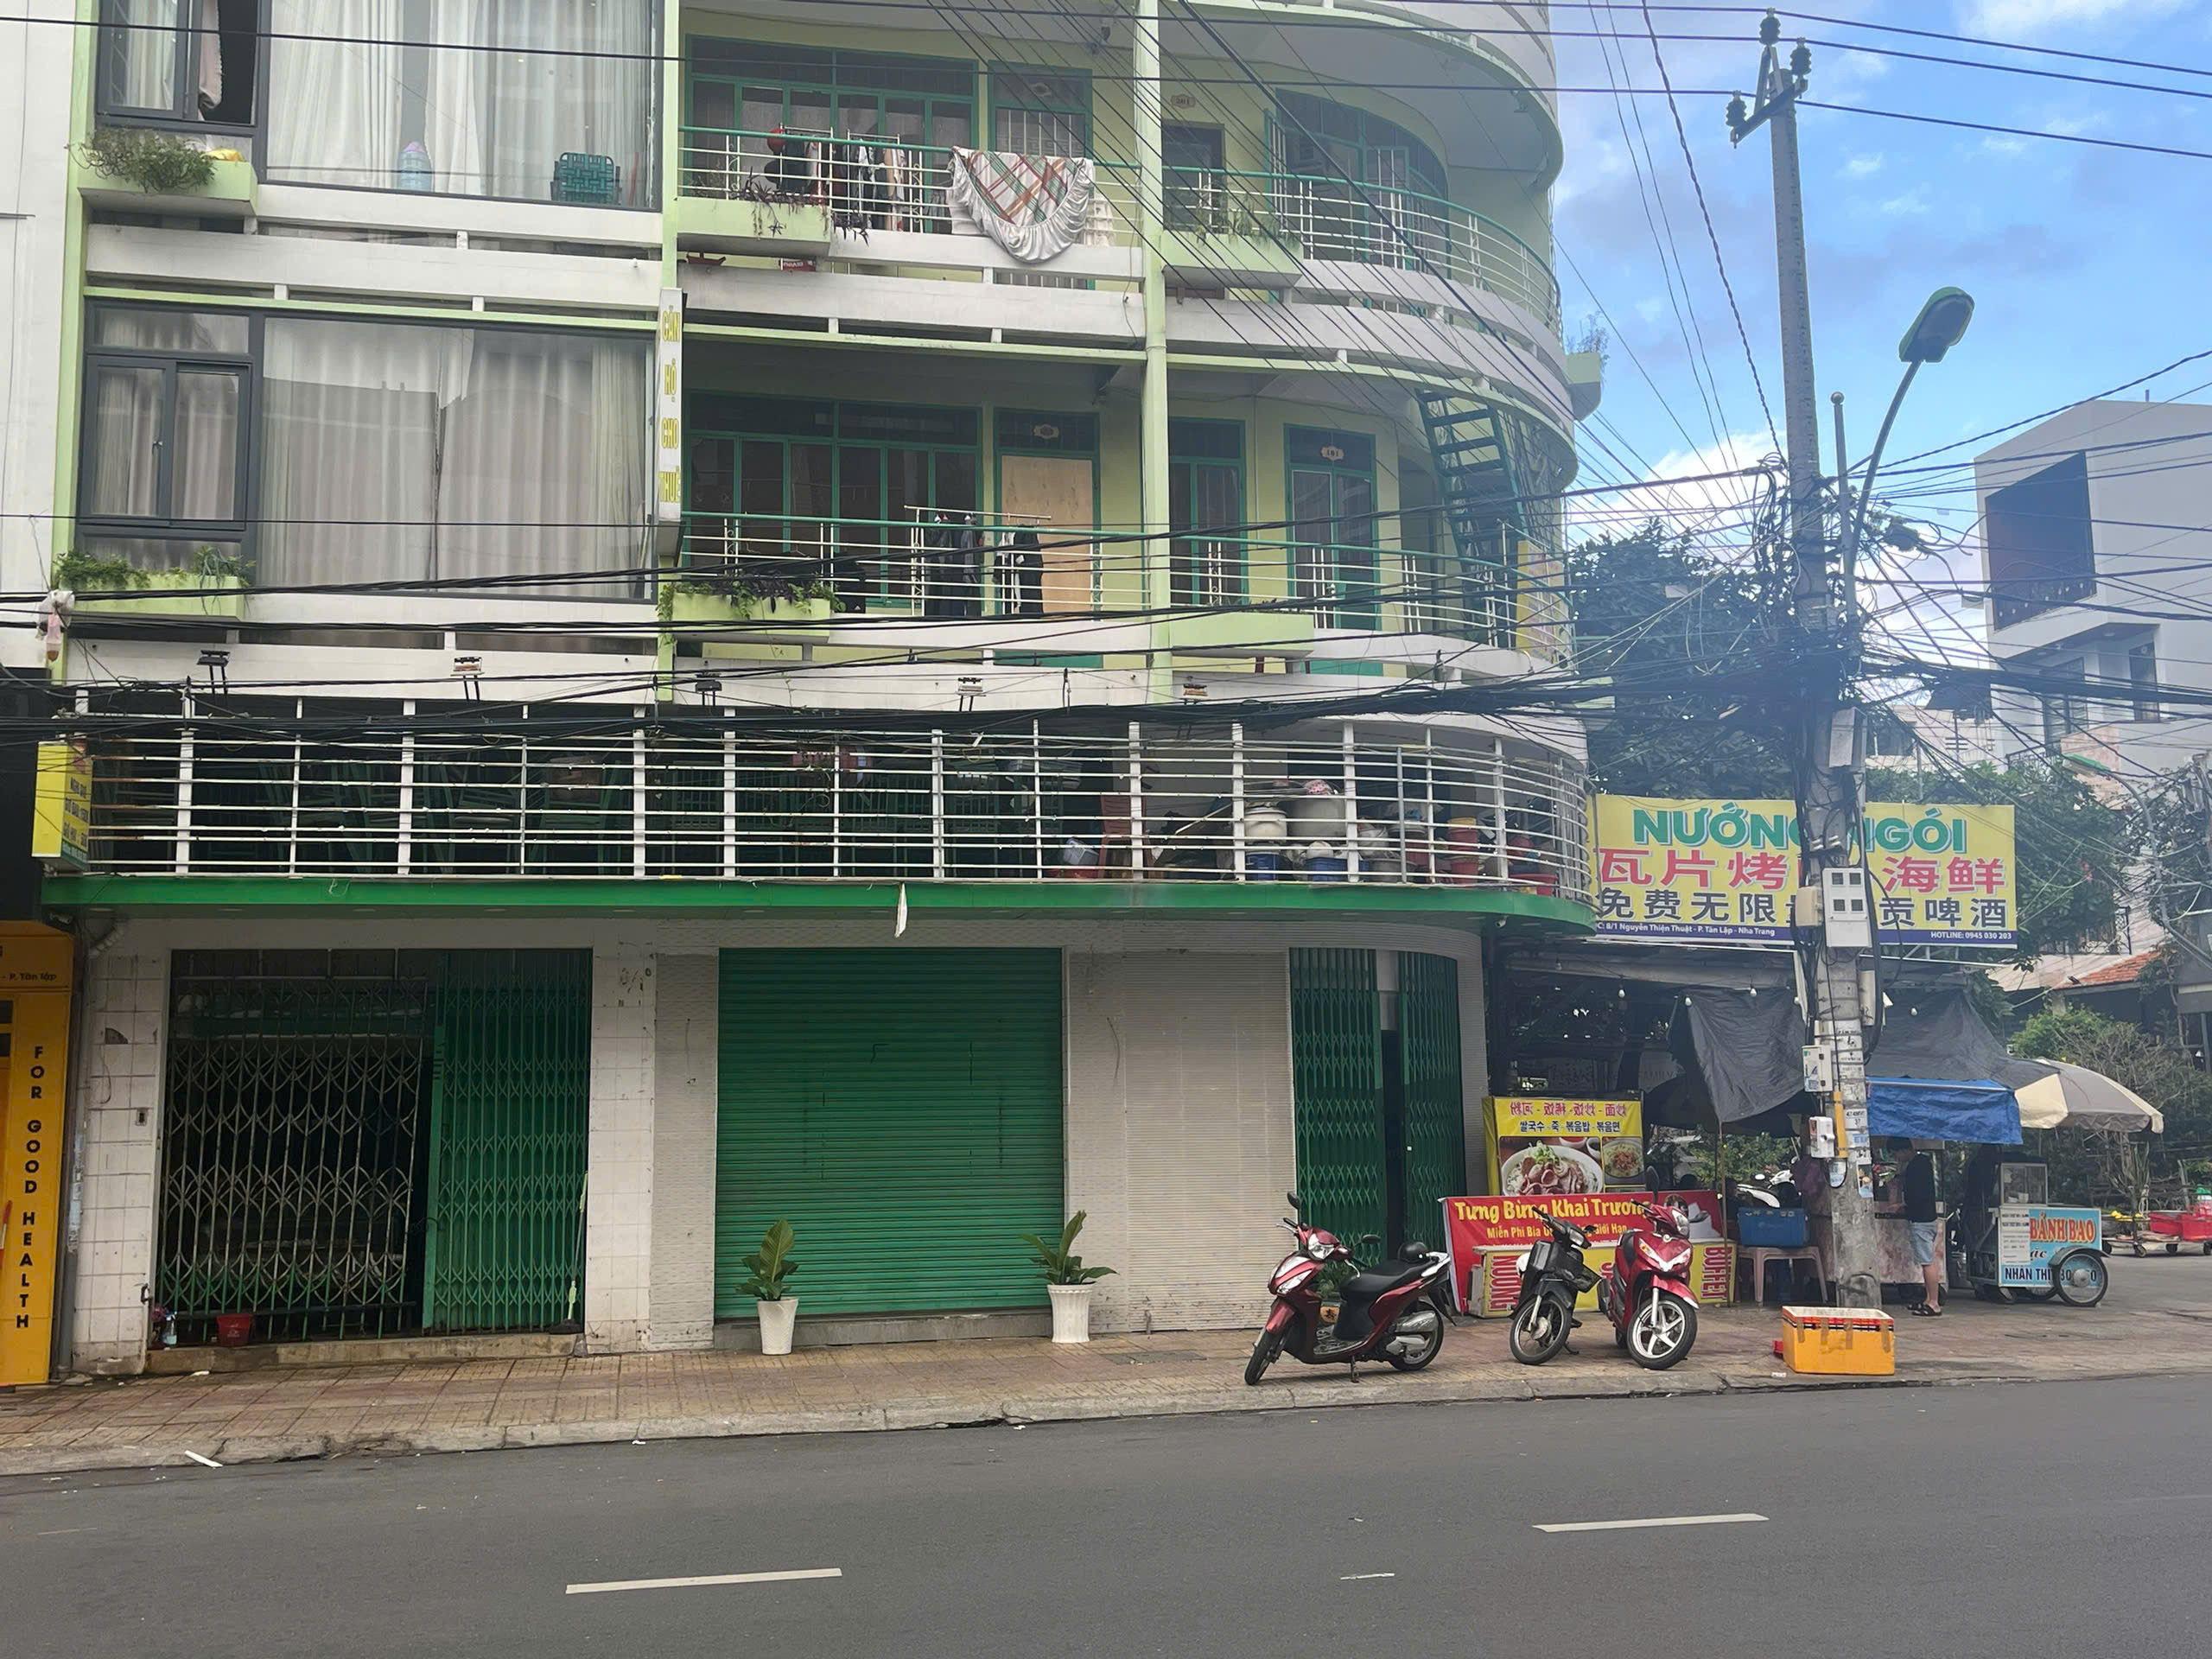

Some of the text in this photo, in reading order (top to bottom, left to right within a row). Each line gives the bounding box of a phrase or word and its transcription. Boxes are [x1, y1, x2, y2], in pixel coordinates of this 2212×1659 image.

[661, 418, 679, 448] CHO
[659, 465, 681, 502] THUÊ
[1649, 924, 1670, 933] Thiện
[1671, 925, 1693, 934] Thuật
[1719, 926, 1733, 935] Lập
[1754, 928, 1776, 937] Trang
[1930, 931, 1963, 939] HOTLINE:
[1520, 1120, 1621, 1133] 쌀국수 죽 볶음밥 볶음면
[16, 1046, 45, 1328] FOR GOOD HEALTH
[1551, 1197, 1590, 1217] Khai
[1527, 1226, 1541, 1237] Bia
[2029, 1211, 2097, 1243] BÁNH BAO
[1702, 1246, 1733, 1298] BUFFET
[2035, 1268, 2052, 1285] THỊ
